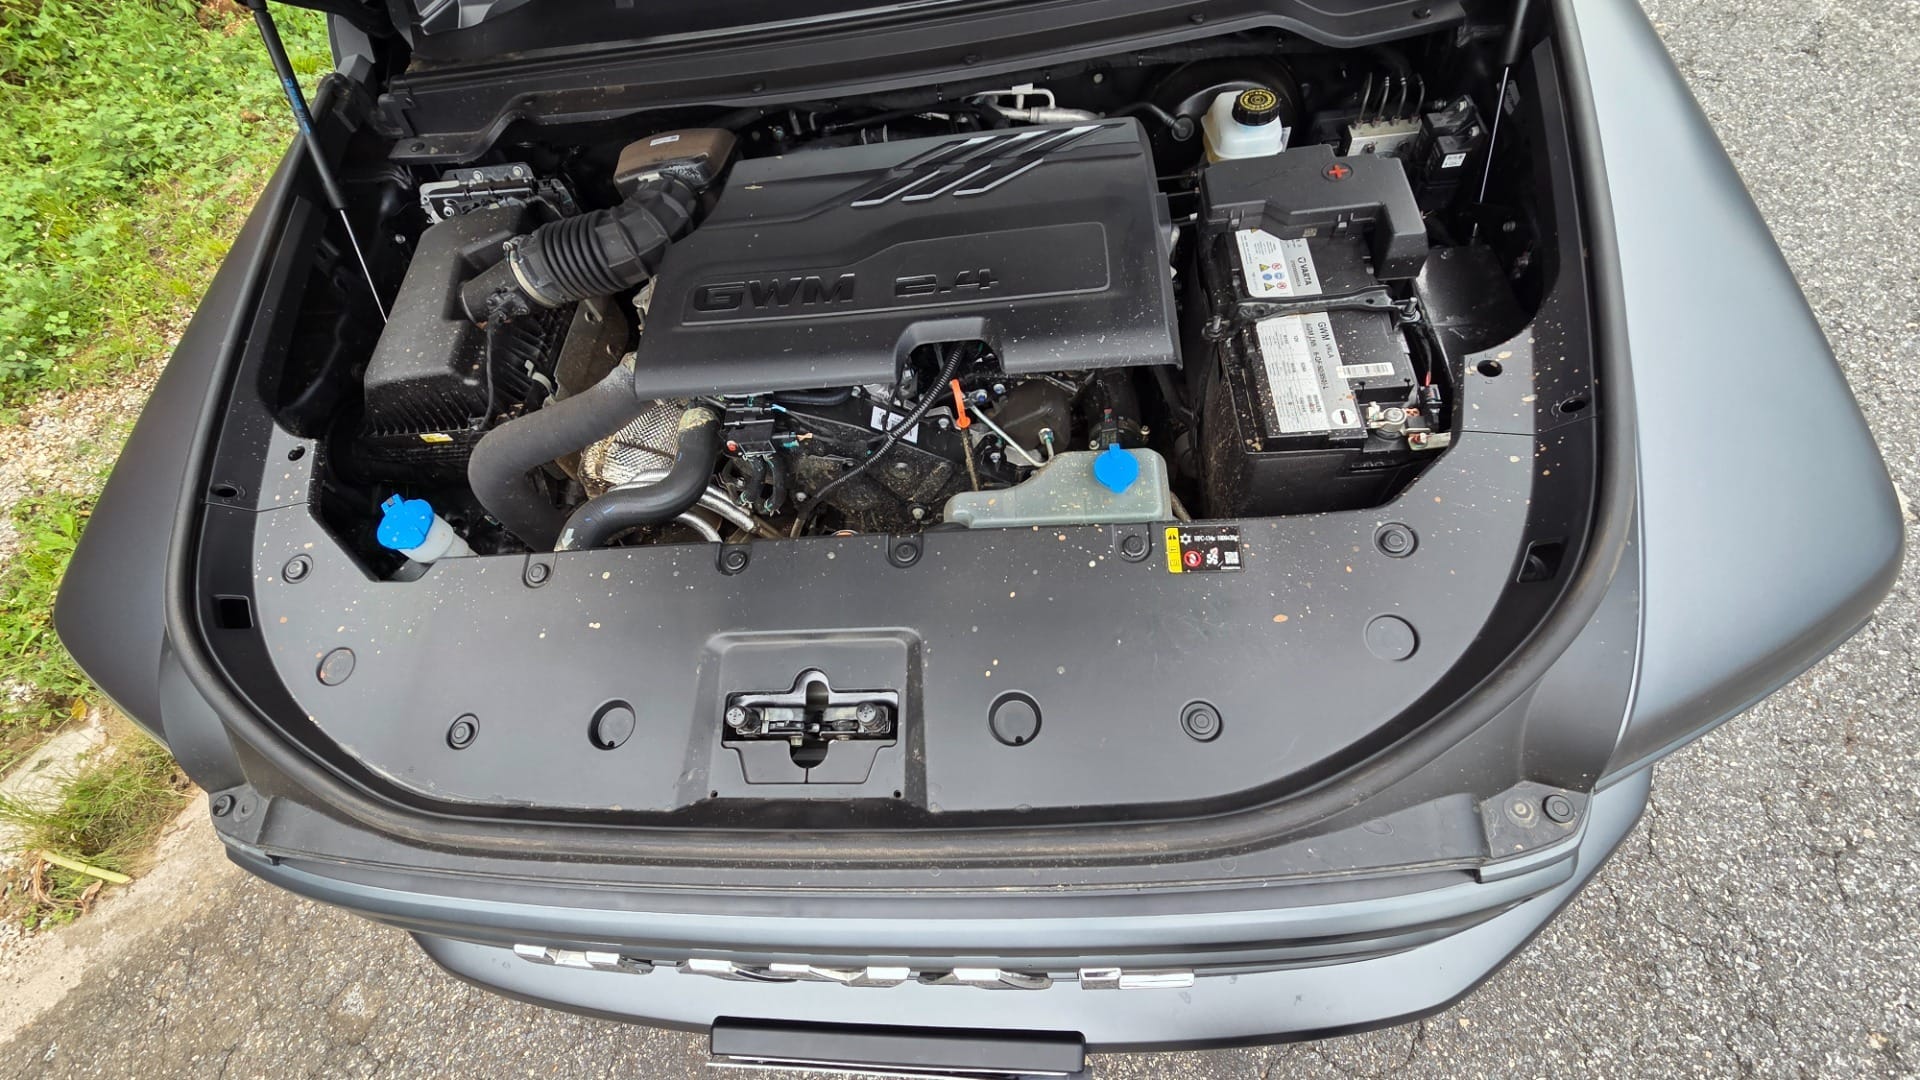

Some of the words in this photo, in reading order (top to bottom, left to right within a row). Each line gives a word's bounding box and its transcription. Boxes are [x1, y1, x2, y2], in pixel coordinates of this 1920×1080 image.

[1300, 263, 1312, 286] VARTA
[693, 273, 856, 312] GWM
[894, 268, 999, 298] 2.4
[1317, 321, 1331, 341] GWM
